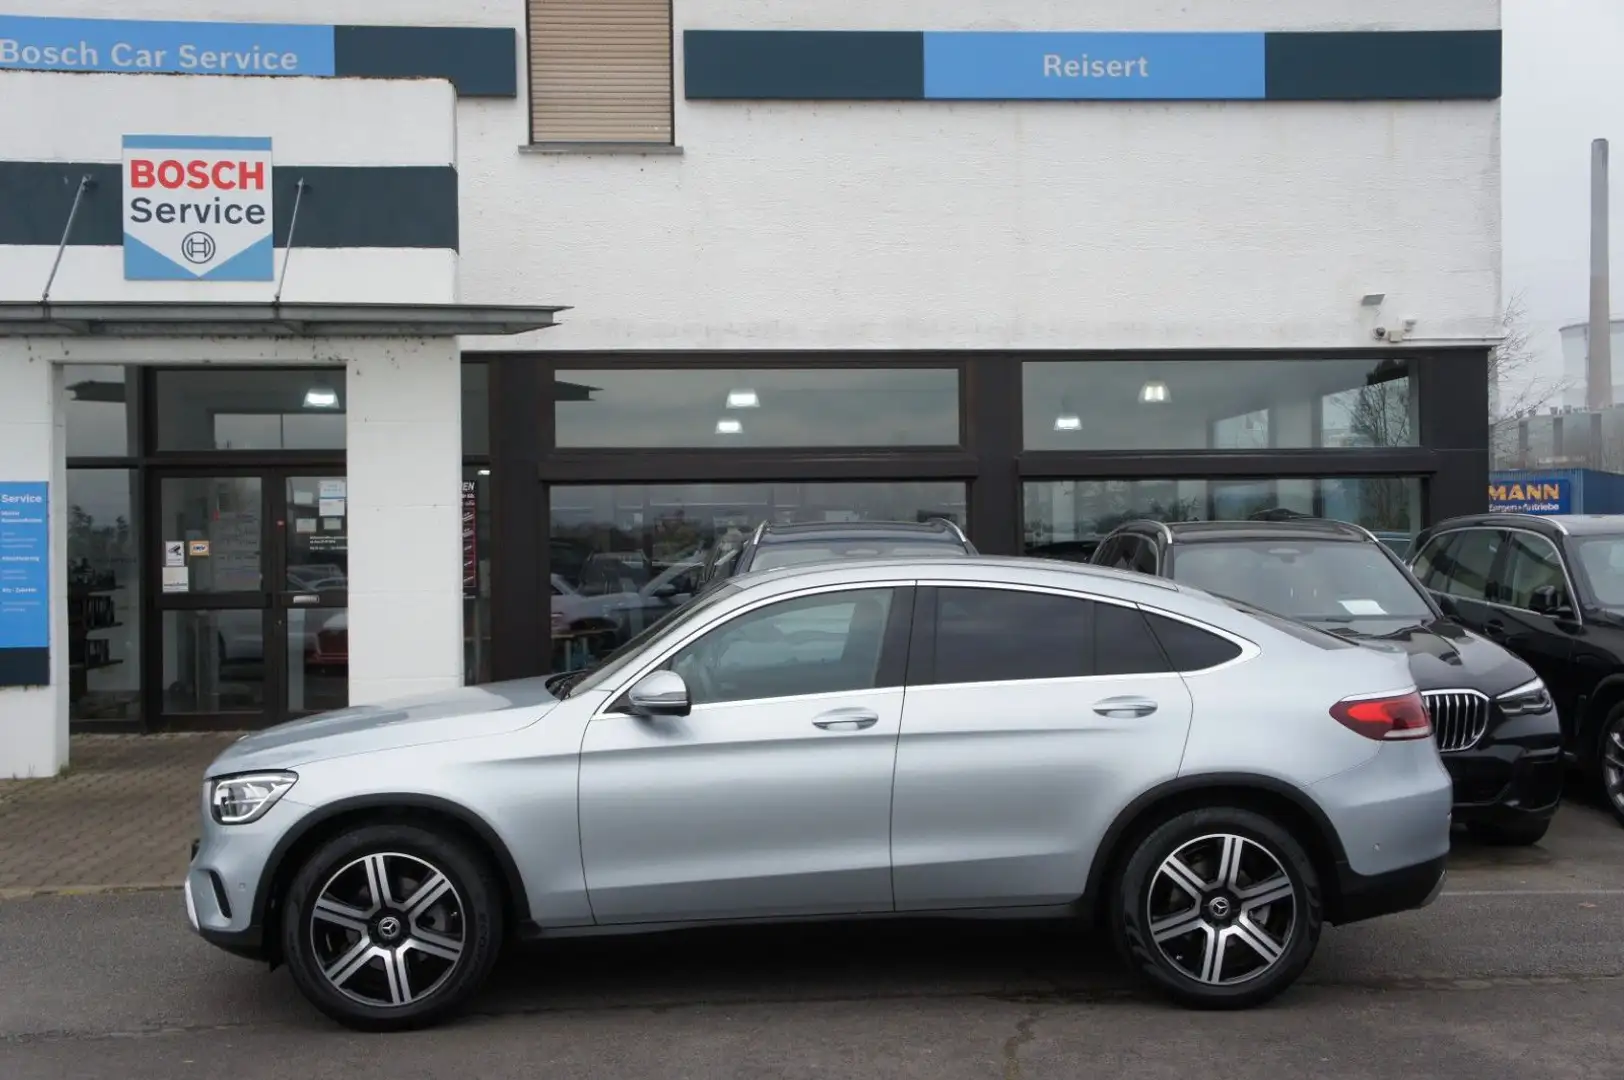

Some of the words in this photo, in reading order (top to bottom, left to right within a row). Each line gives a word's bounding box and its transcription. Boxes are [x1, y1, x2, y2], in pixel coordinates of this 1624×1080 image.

[0, 38, 98, 67] Bosch
[111, 43, 167, 68] Car
[179, 44, 298, 71] Service
[1043, 53, 1149, 78] Reisert
[130, 159, 264, 190] BOSCH
[130, 196, 266, 225] Service
[1, 494, 42, 503] Service
[1488, 483, 1559, 500] MANN
